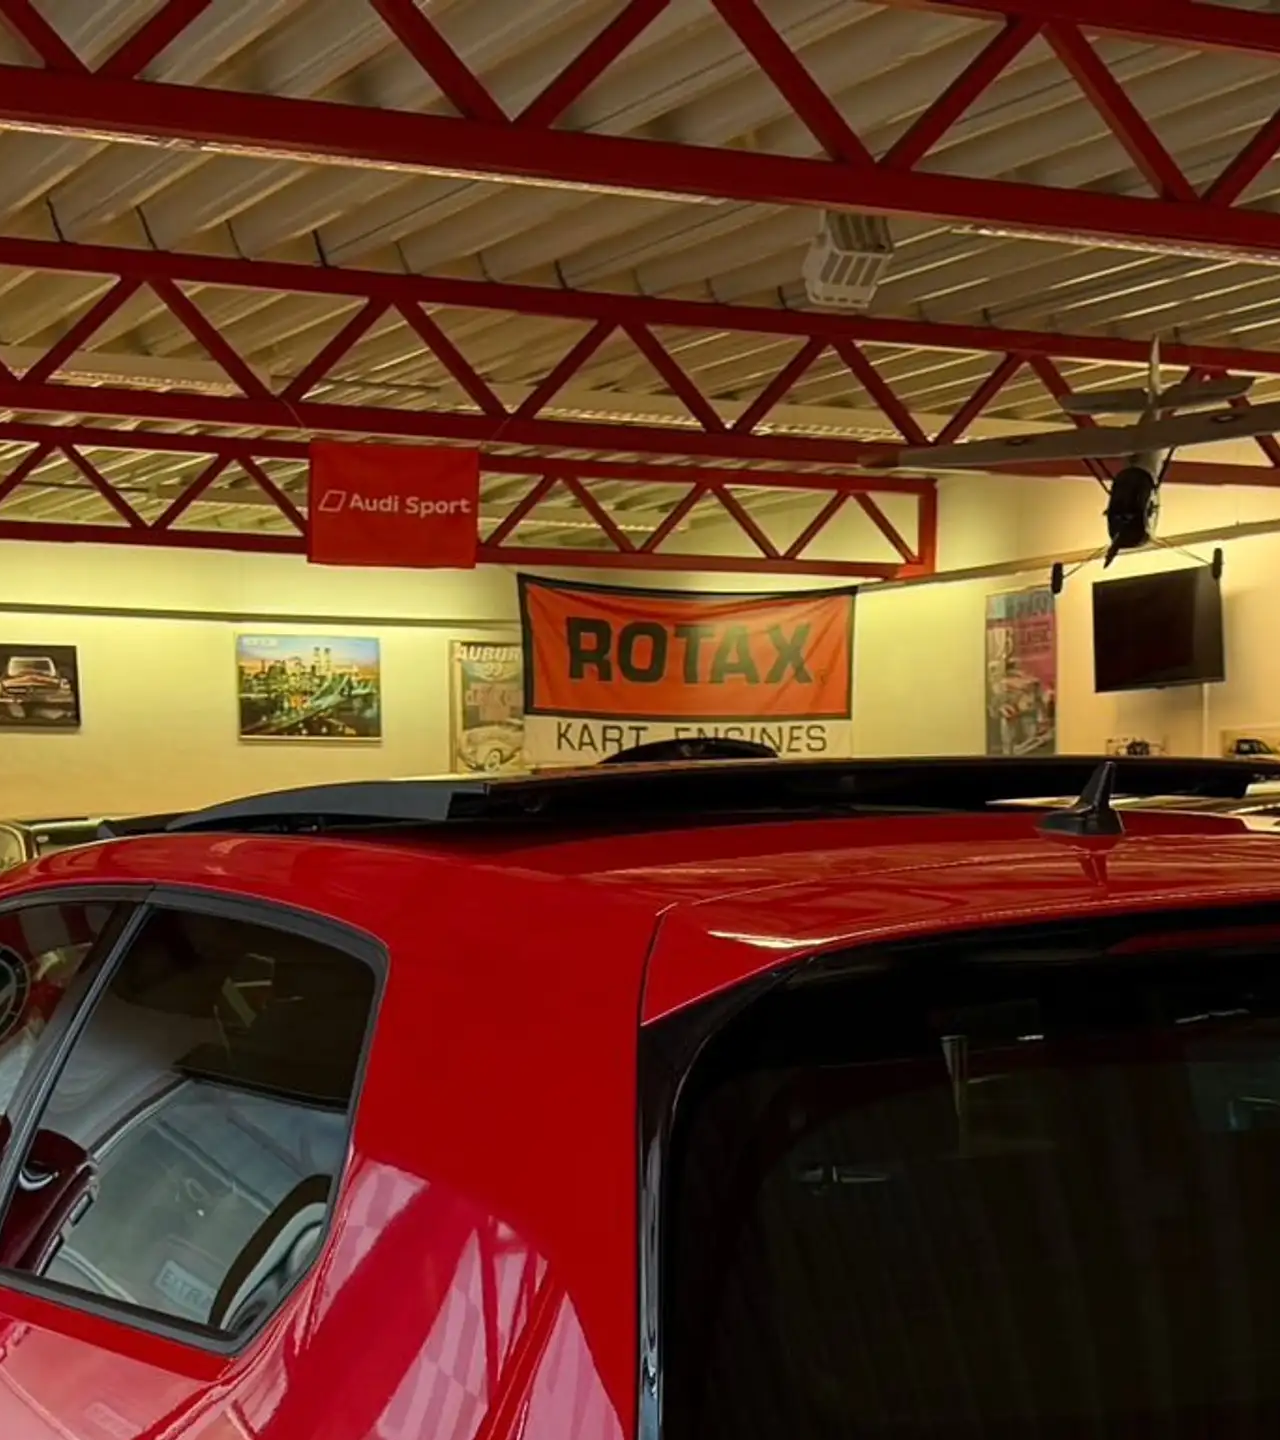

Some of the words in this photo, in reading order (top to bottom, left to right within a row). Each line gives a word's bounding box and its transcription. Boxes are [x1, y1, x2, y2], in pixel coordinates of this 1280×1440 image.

[349, 493, 400, 512] Audi
[405, 496, 472, 519] Sport
[566, 616, 813, 685] ROTAX
[556, 721, 648, 752] KART
